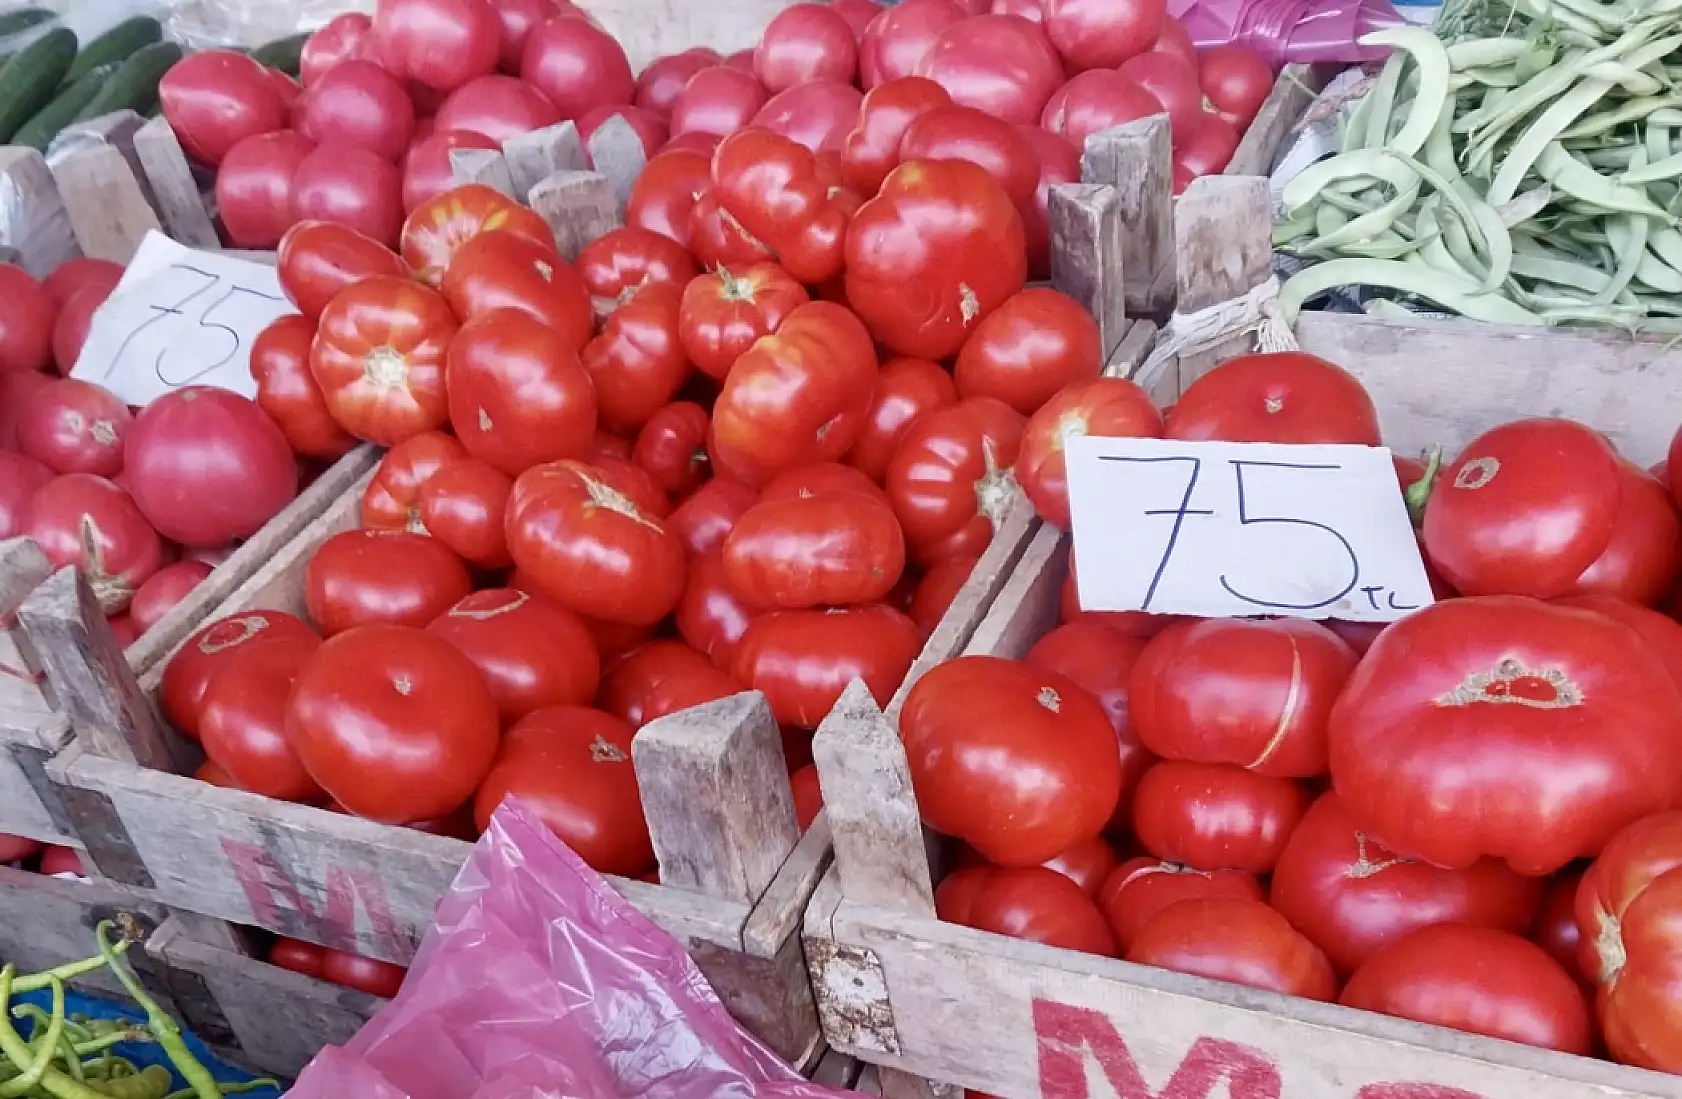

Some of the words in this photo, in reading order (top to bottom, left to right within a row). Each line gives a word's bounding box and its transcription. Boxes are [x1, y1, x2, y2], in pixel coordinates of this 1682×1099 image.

[104, 263, 286, 387] 75
[1097, 455, 1359, 610] 75
[1360, 585, 1420, 611] TL
